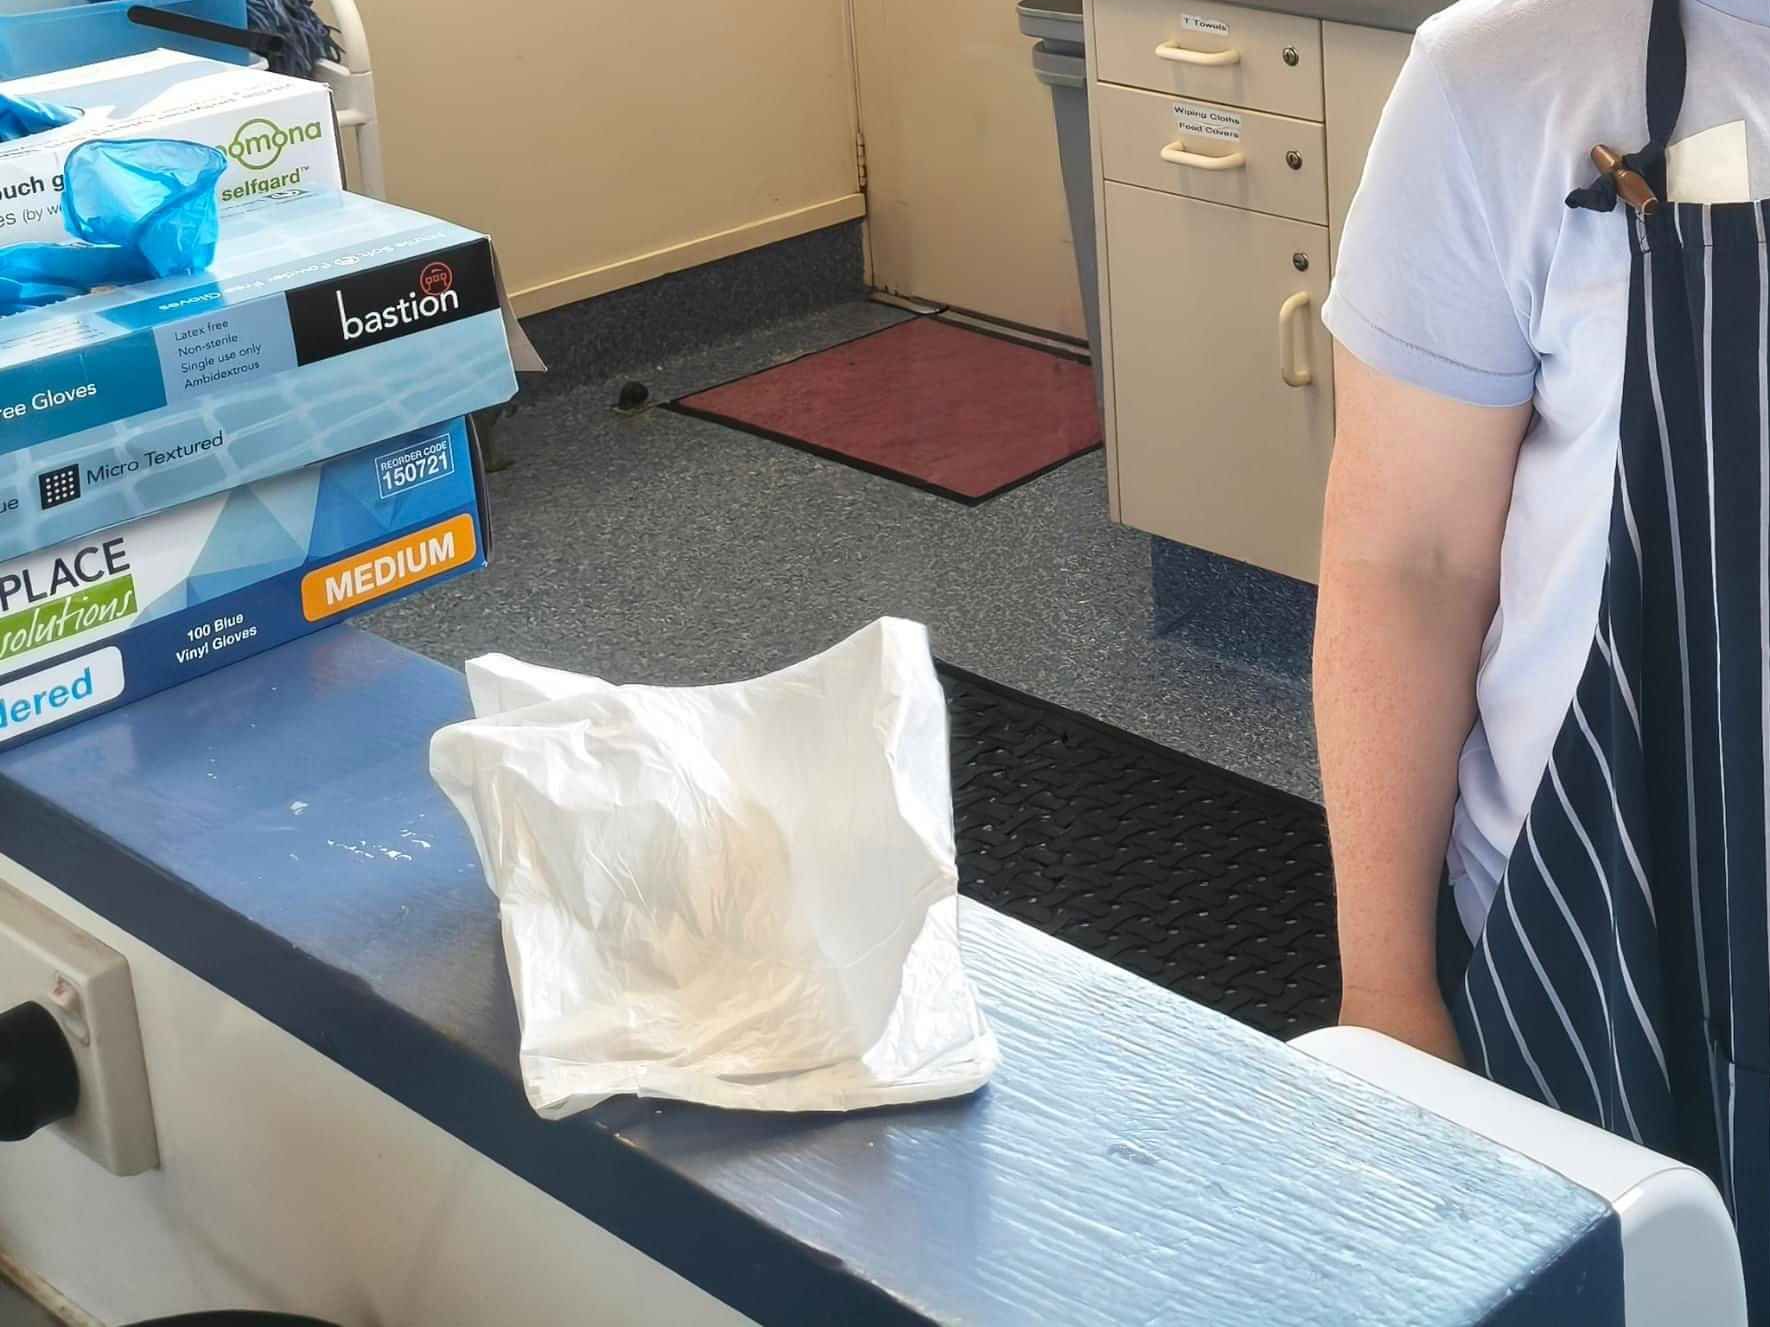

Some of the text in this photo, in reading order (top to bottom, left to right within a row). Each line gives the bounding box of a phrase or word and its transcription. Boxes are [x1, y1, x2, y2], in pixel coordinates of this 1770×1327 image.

[1174, 105, 1240, 125] Wiping Cloths
[1179, 122, 1239, 139] Food Covers
[0, 176, 45, 200] uch
[336, 289, 459, 340] bastion
[175, 320, 229, 341] Latex free
[178, 334, 238, 357] Non-sterile
[181, 343, 262, 374] Single use only
[184, 361, 260, 389] Ambidextrous
[31, 383, 97, 410] Gloves
[86, 430, 224, 485] Micro Textured
[380, 440, 448, 471] REORDER CODE
[382, 452, 448, 489] 150721
[0, 537, 131, 611] PLACE
[325, 531, 456, 605] MEDIUM
[0, 589, 133, 656] solutions
[187, 613, 244, 642] 100 Blue
[175, 626, 257, 664] Vinyl Gloves
